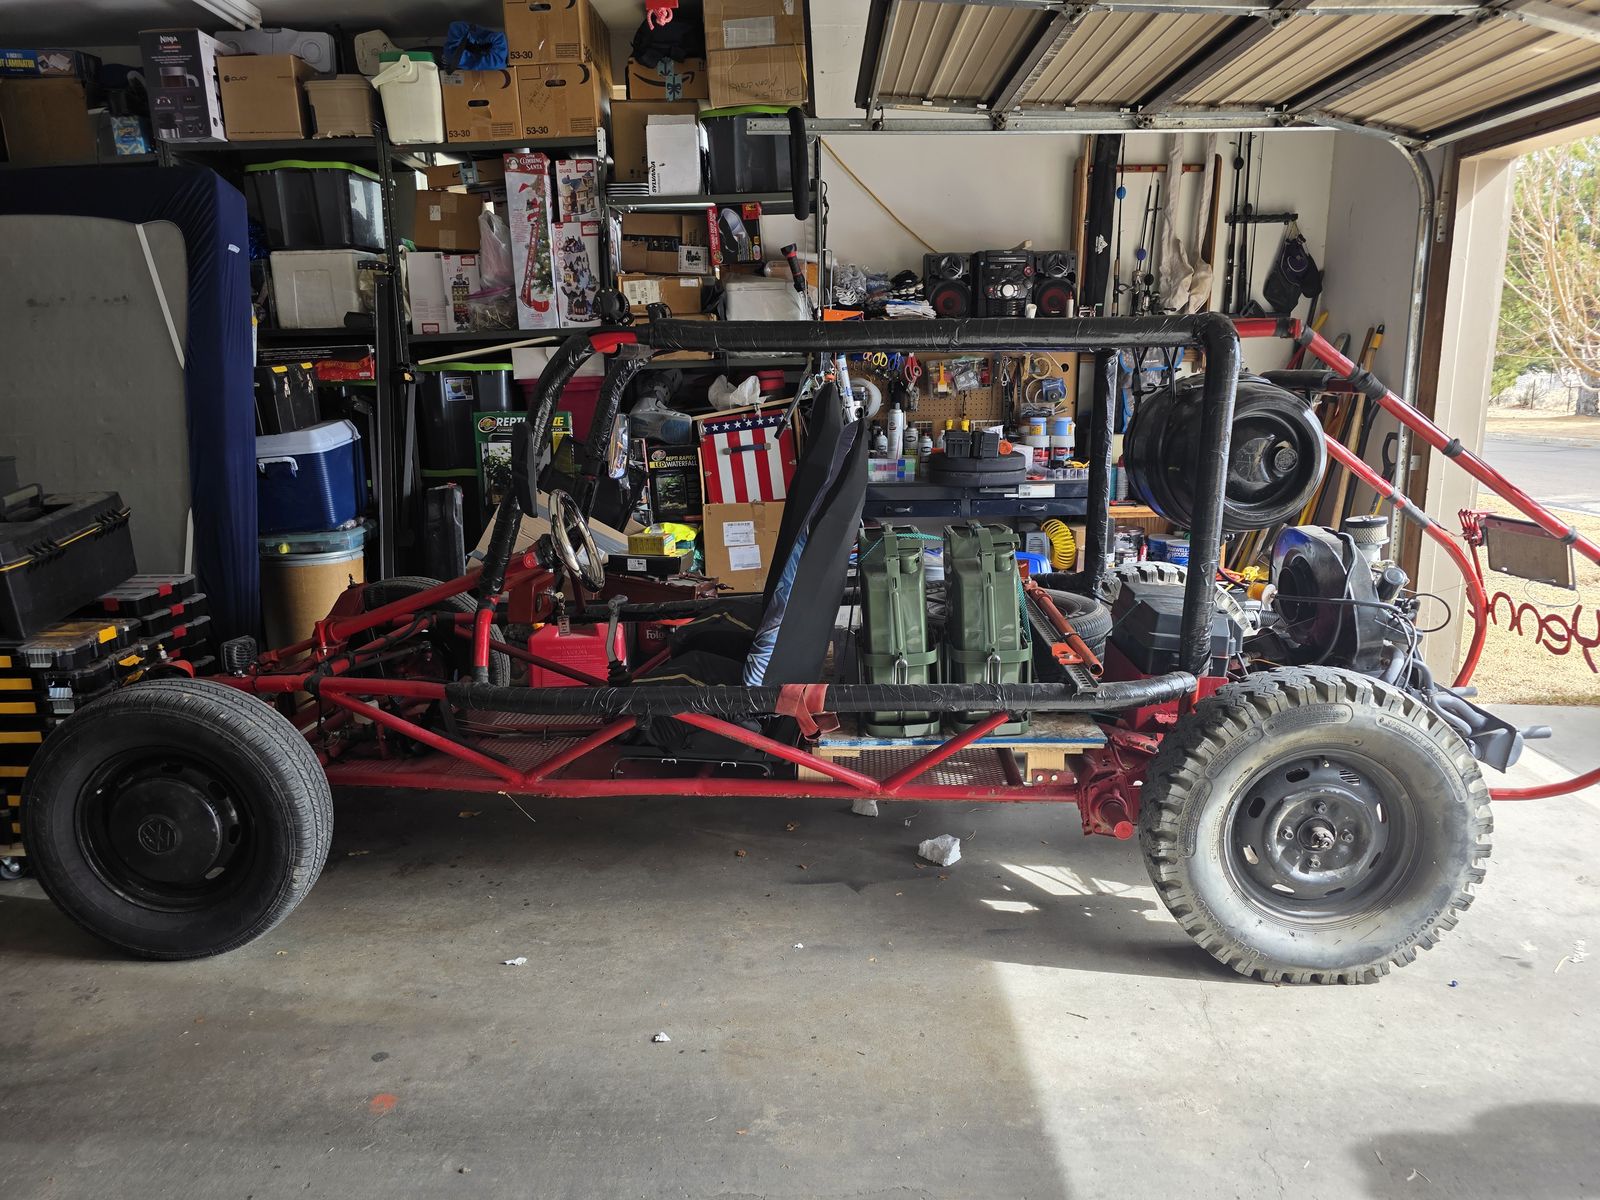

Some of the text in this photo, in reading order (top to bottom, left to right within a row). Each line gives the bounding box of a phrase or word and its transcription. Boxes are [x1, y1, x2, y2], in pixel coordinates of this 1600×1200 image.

[160, 35, 178, 44] NINJA
[510, 50, 533, 59] 53-30
[449, 129, 470, 138] 53-30
[526, 126, 549, 135] 53-30
[497, 417, 526, 427] REPTI
[1224, 736, 1246, 754] RANGE
